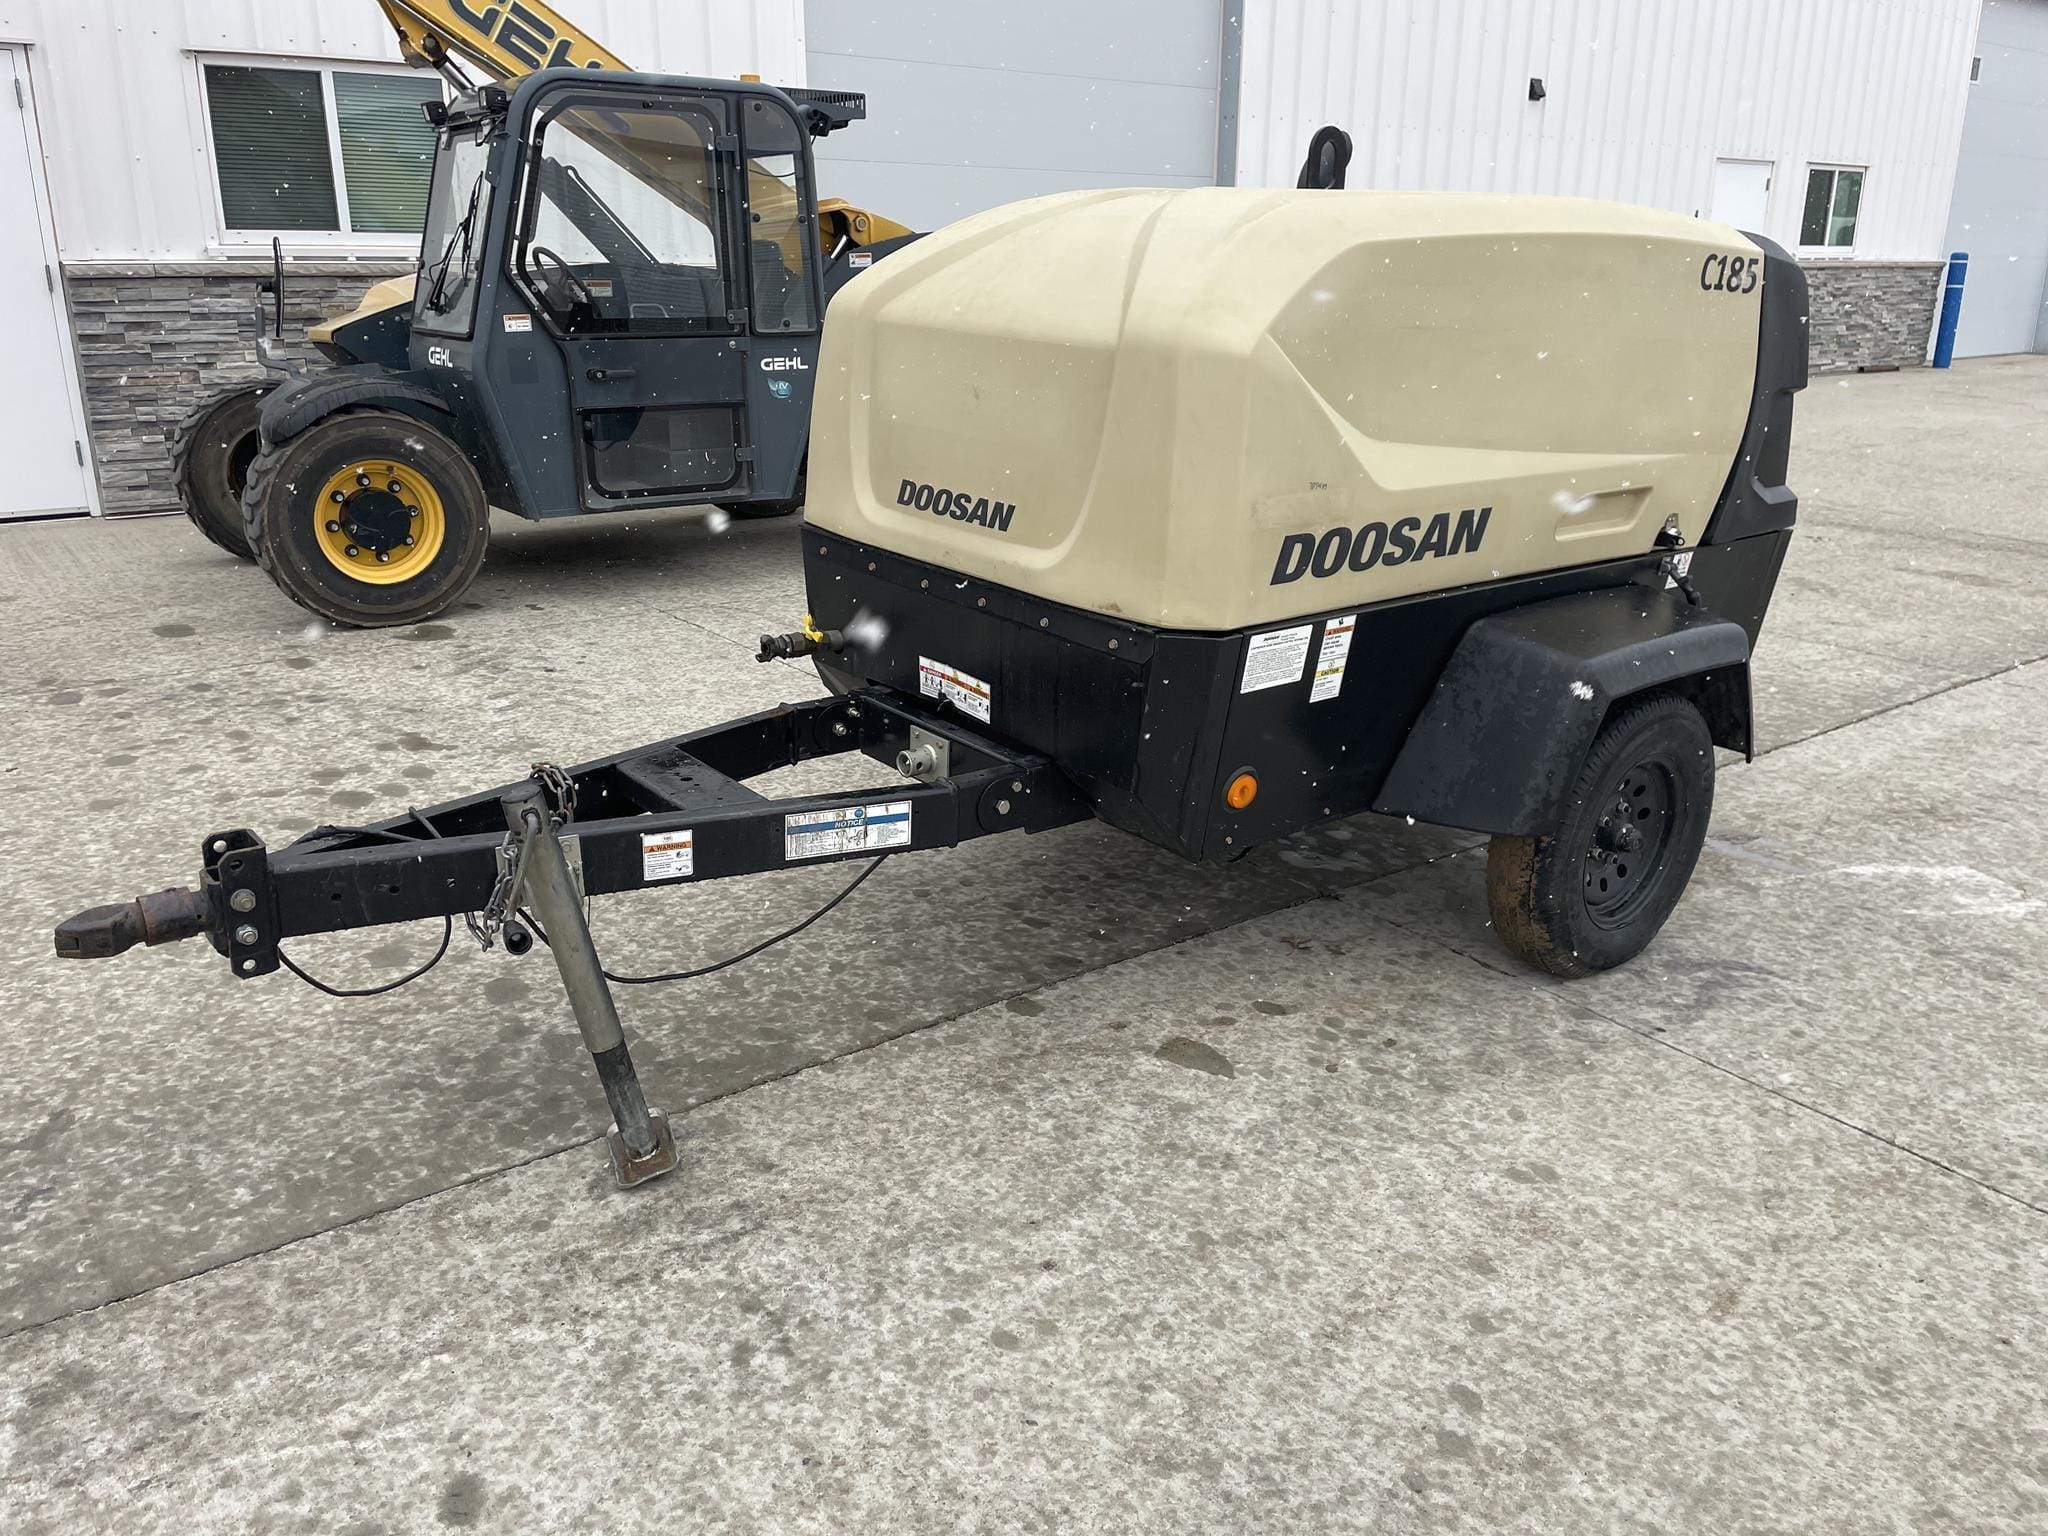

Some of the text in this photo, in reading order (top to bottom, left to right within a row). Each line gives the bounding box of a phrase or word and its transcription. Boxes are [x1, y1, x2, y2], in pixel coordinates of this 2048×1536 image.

[1700, 253, 1760, 294] C185
[428, 346, 454, 368] GEHL
[760, 356, 809, 371] GEHL
[896, 479, 1017, 532] DOOSAN
[1269, 506, 1493, 586] DOOSAN
[1320, 667, 1340, 677] CAUTION
[834, 819, 865, 829] NOTICE
[656, 842, 687, 851] WARNING
